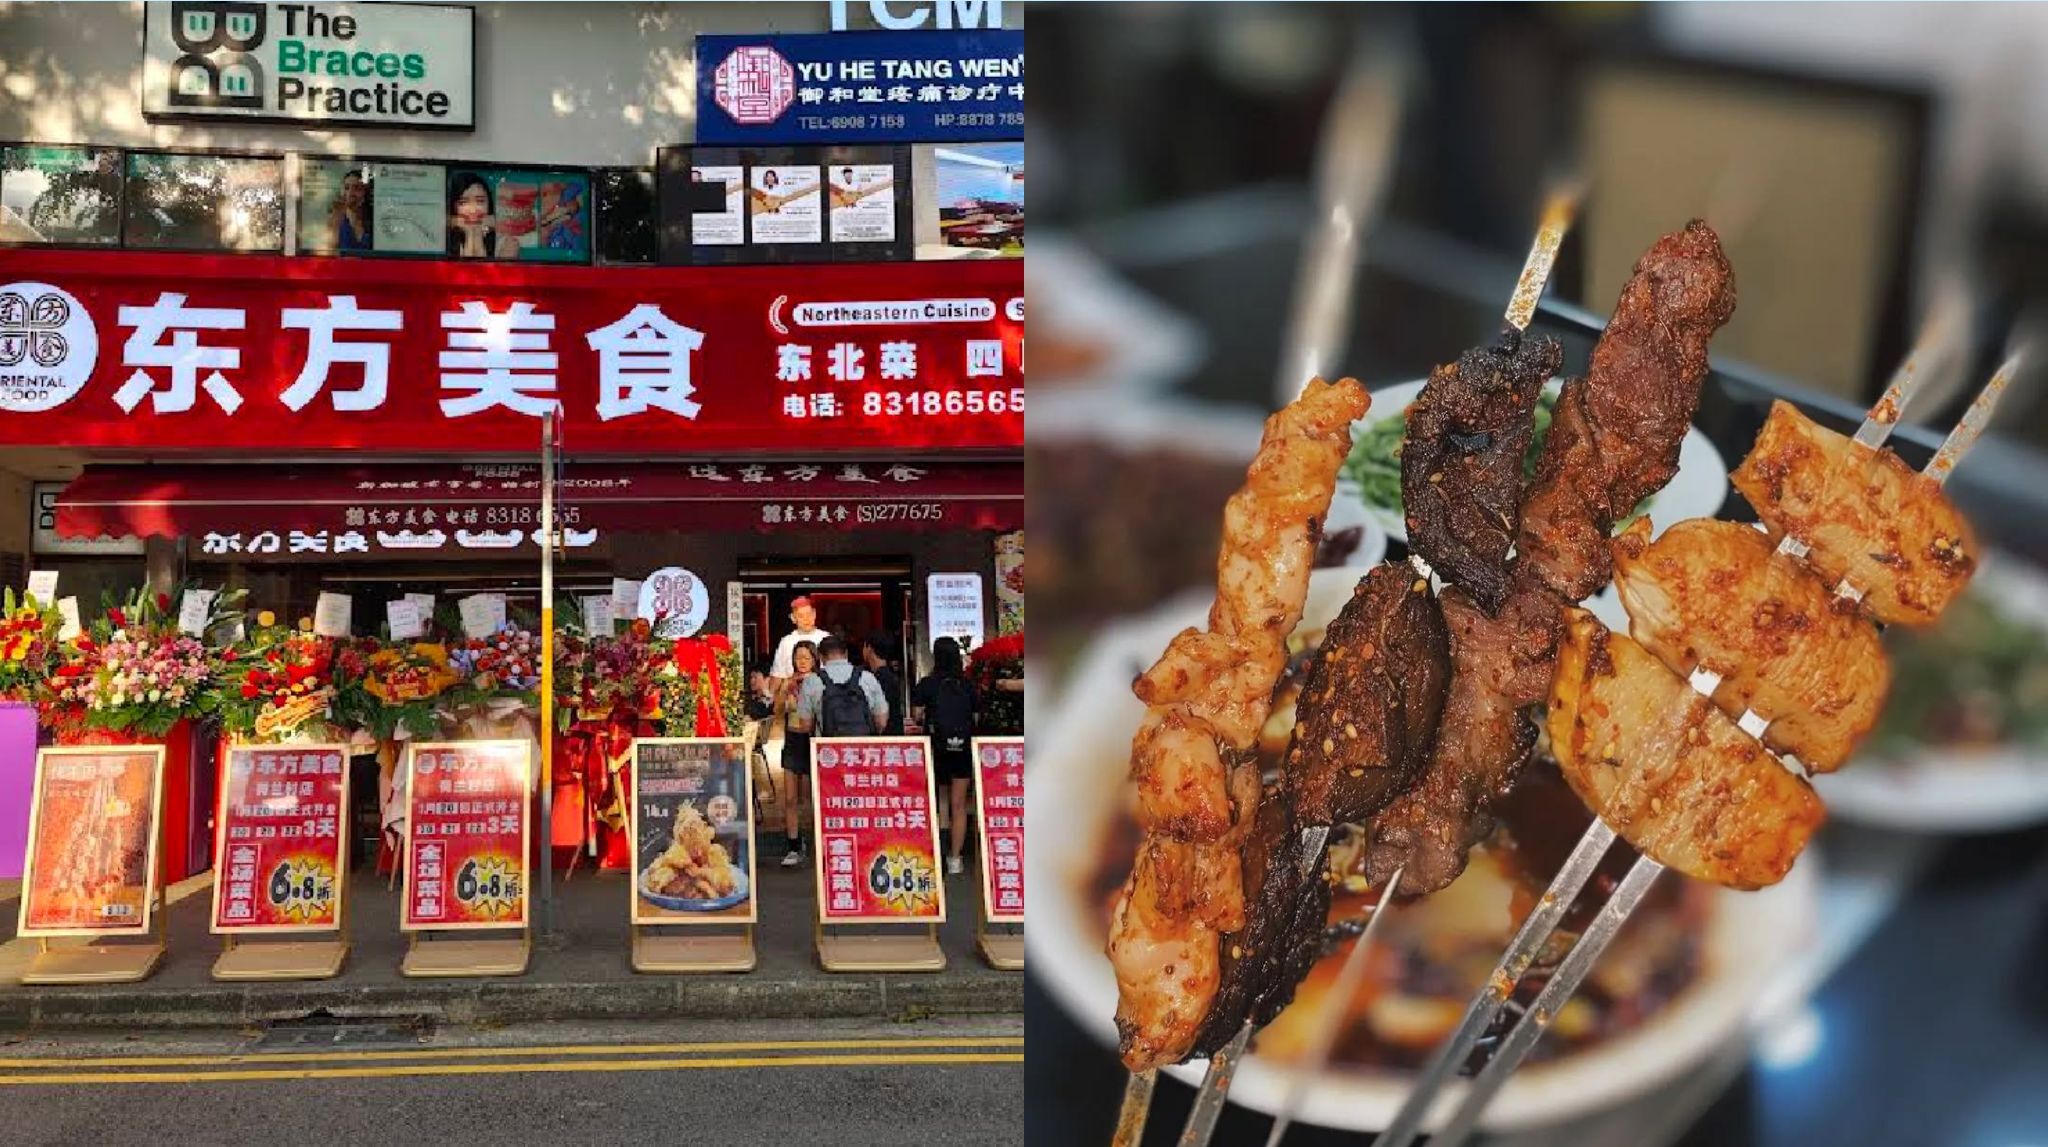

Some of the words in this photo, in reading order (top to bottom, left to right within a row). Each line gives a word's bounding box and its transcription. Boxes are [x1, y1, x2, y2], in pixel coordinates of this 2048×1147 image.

[277, 5, 356, 39] The
[277, 39, 425, 78] Braces
[798, 62, 833, 82] YU
[840, 60, 876, 80] HE
[881, 60, 953, 79] TANG
[278, 76, 449, 114] Practice
[802, 306, 919, 322] Northeastern
[924, 303, 991, 319] Cuisine
[113, 292, 707, 422] 东方美食
[775, 340, 918, 382] 东北菜
[486, 506, 532, 525] 8318
[257, 752, 342, 775] 东方美食
[842, 746, 924, 767] 东方美食
